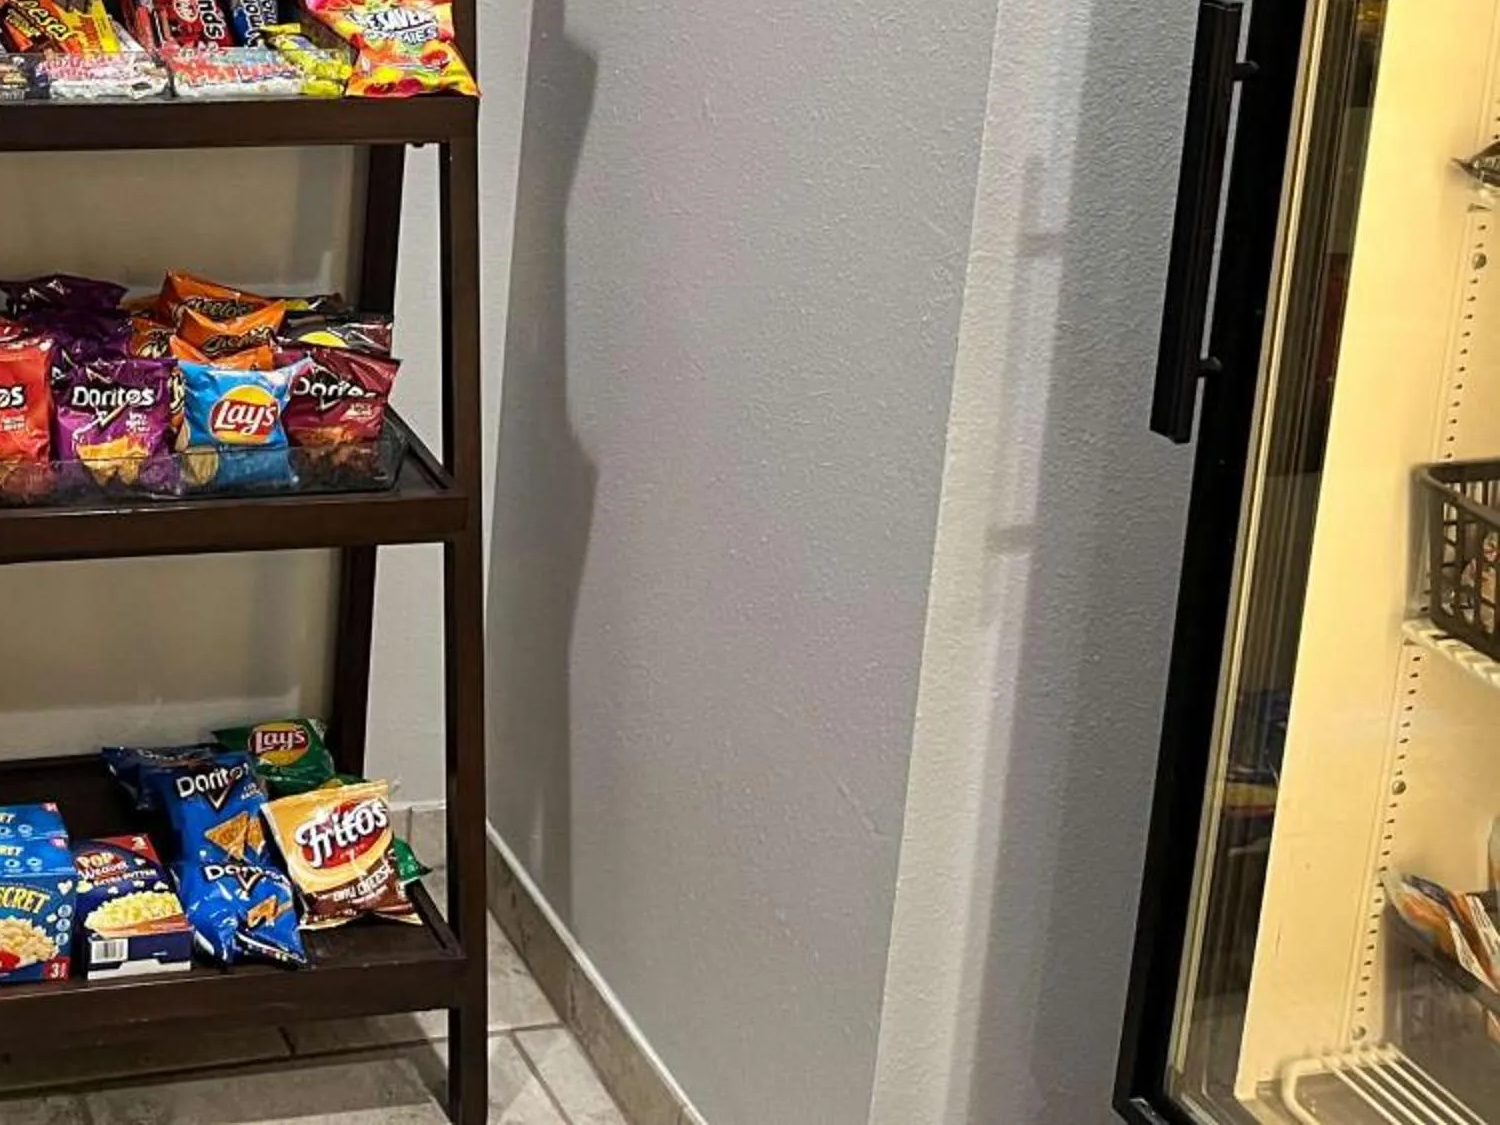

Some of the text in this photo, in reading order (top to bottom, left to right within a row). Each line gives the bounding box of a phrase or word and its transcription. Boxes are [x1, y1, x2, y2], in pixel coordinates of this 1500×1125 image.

[71, 385, 155, 408] Doritos
[214, 399, 278, 434] Lay's
[254, 725, 306, 755] Lay's
[295, 797, 388, 868] Fritos
